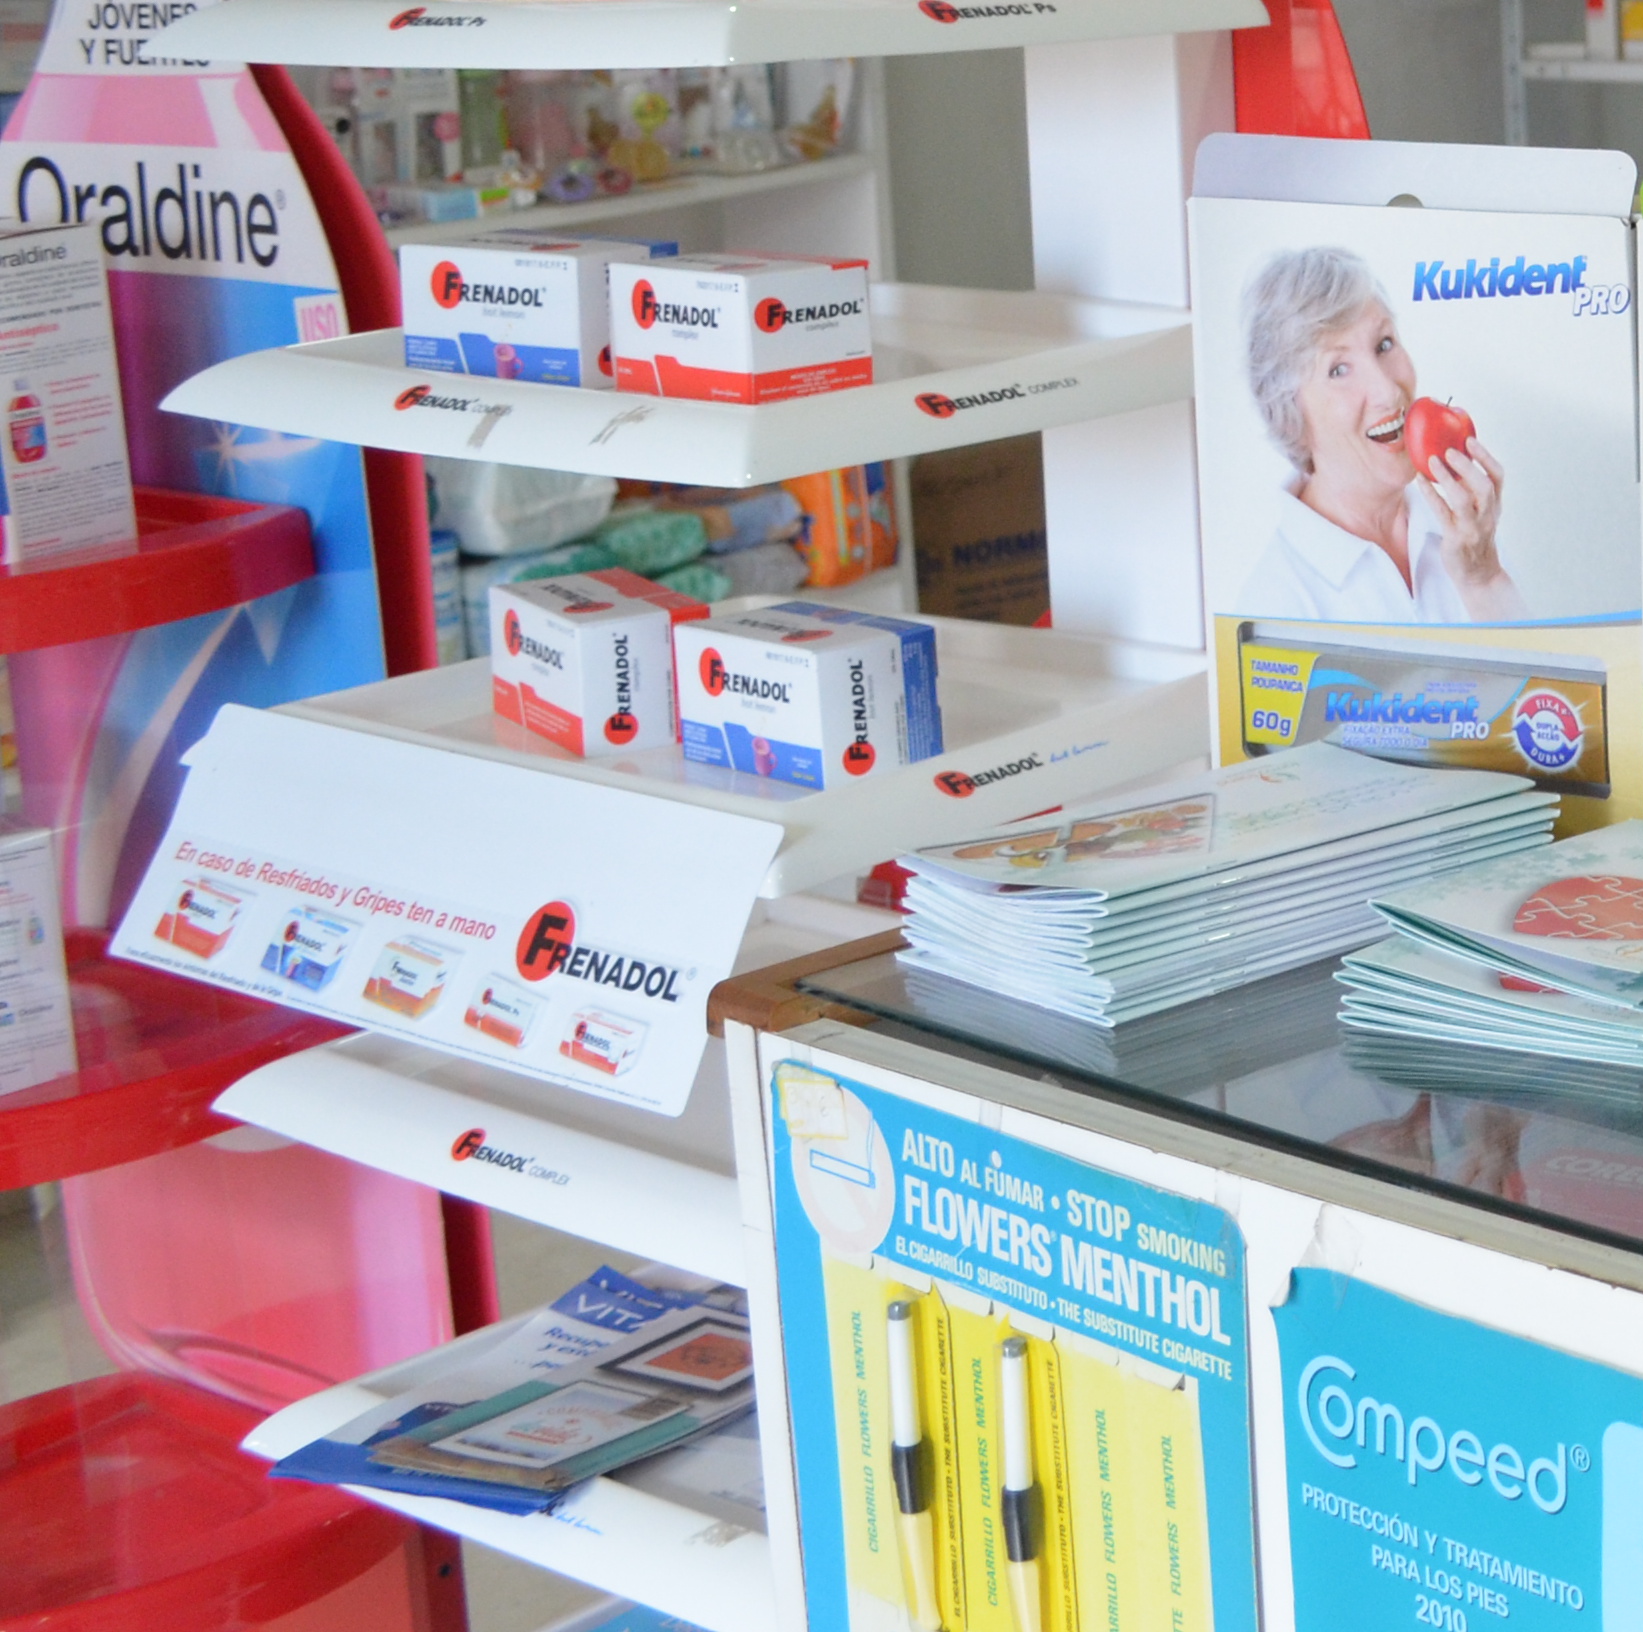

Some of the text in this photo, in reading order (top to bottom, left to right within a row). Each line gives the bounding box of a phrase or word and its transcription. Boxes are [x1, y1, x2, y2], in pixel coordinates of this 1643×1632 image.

[17, 156, 279, 267] Oraldine
[443, 272, 543, 307] FRENADOL
[1413, 253, 1587, 303] Kukident
[1571, 285, 1631, 317] PRO
[641, 291, 718, 328] FRENADOL
[767, 302, 861, 327] FRENADOL
[922, 377, 1080, 418] FRENADOL COMPLEX
[509, 622, 564, 671] FRENADOL
[1251, 659, 1299, 676] TAMANHO
[611, 634, 628, 732] FRENADOL
[709, 657, 791, 704] FRENADOL
[848, 659, 864, 761] FRENADOL
[1252, 710, 1292, 737] 60g
[1324, 692, 1480, 724] Kukident
[1449, 721, 1490, 740] PRO
[175, 841, 498, 941] En caso de Resfriados y Gripes ten a mano
[523, 913, 679, 1003] FRENADOL
[455, 1131, 528, 1175] FRENADOL
[900, 1127, 1227, 1278] ALTO AL FUMAR STOP SMOKING
[902, 1172, 1233, 1346] FLOWERS MENTHOL
[895, 1236, 1234, 1383] EL CIGARRILLO SUBSTITUTO THE SUBSTITUTE CIGARETTE
[852, 1309, 880, 1554] CIGARRILLO FLOWERS MENTHOL
[1298, 1354, 1571, 1516] Compeed
[1300, 1480, 1586, 1612] PROTECCIÓN Y TRATAMIENTO
[1370, 1542, 1511, 1618] PARA LOS PIES
